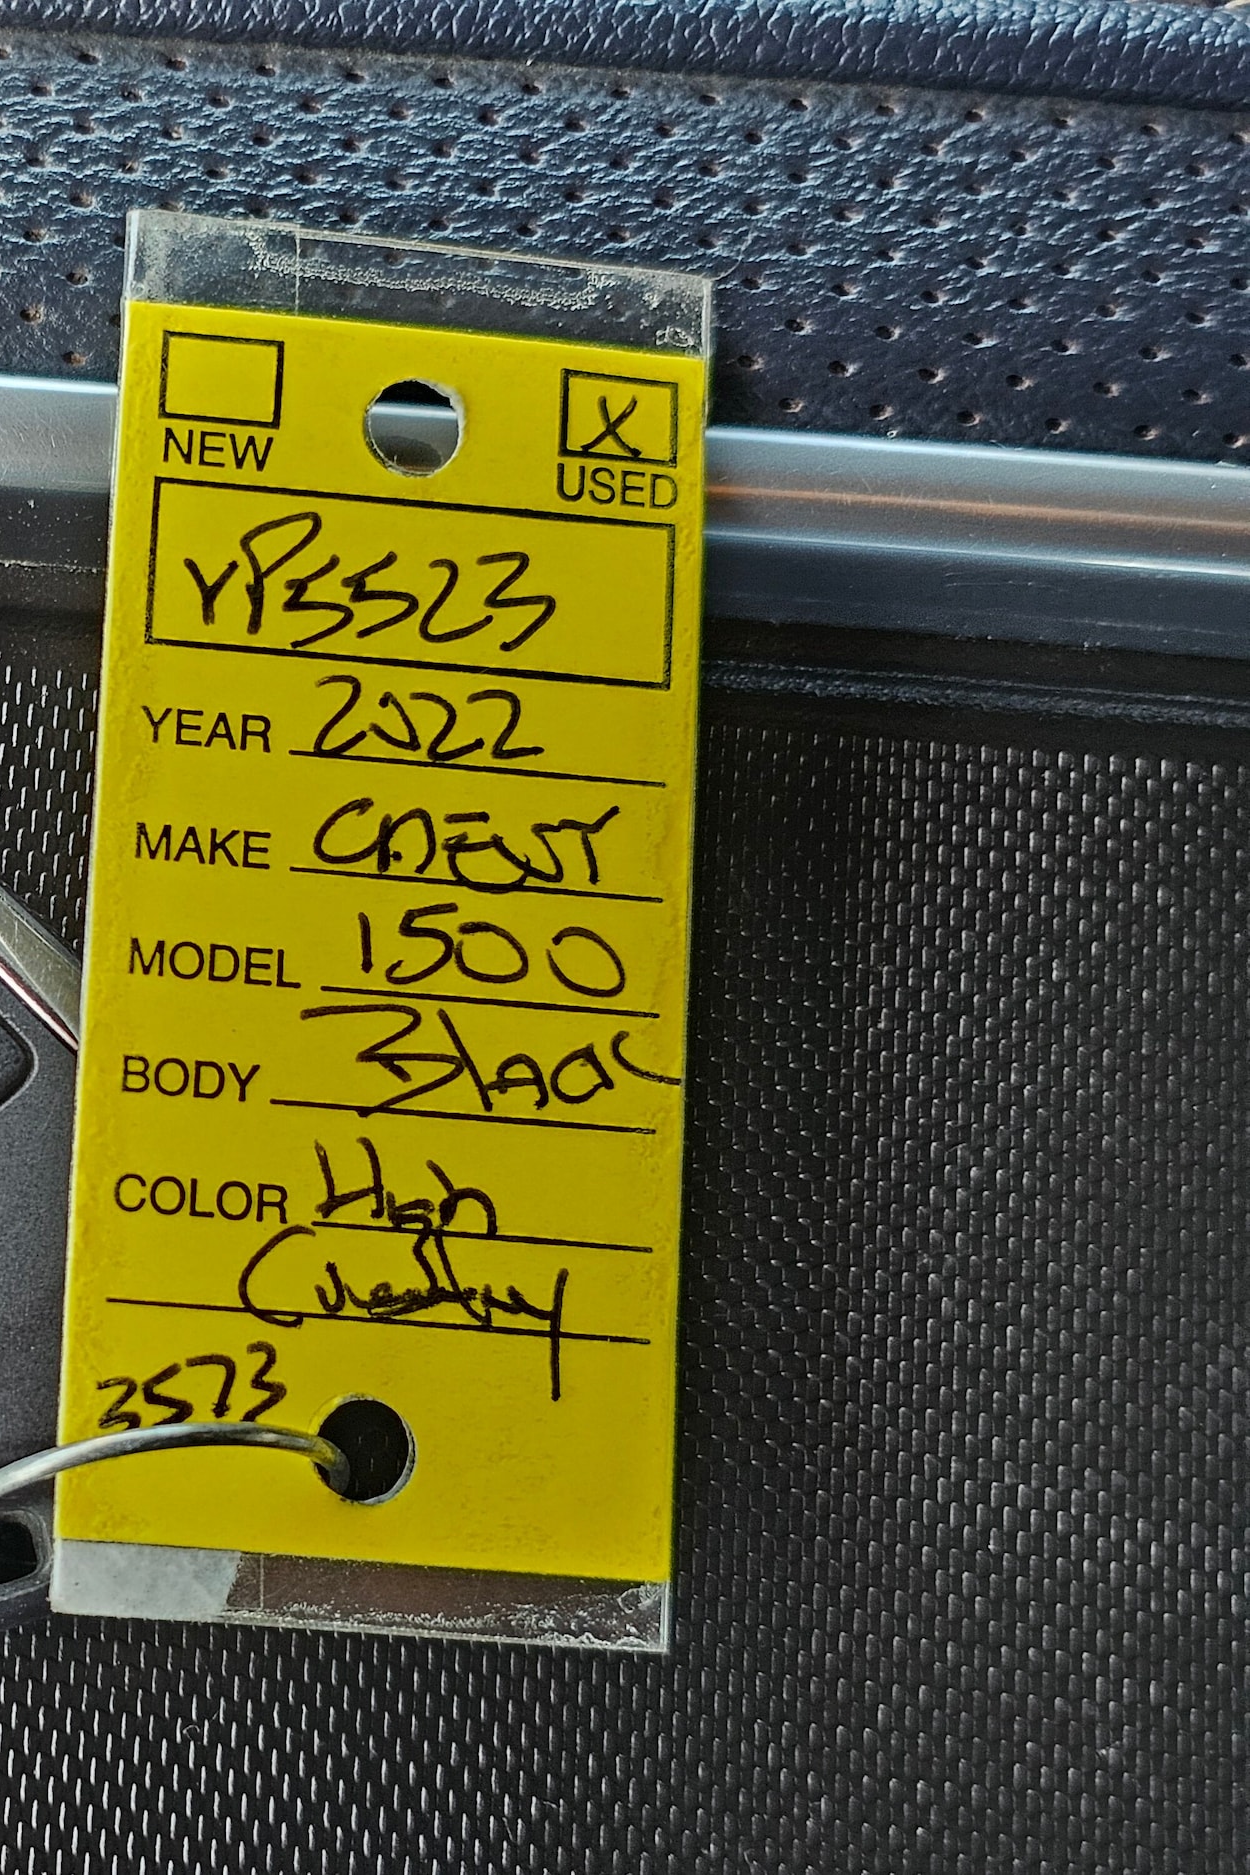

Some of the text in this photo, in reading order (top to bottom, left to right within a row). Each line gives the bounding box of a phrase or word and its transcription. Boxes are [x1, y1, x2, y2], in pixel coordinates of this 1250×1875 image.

[161, 427, 275, 472] NEW
[556, 462, 678, 509] USED
[142, 705, 271, 755] YEAR
[316, 675, 545, 763] 2022
[135, 821, 271, 869] MAKE
[128, 936, 301, 989] MODEL
[357, 902, 628, 999] 1500
[122, 1055, 261, 1102] BODY
[114, 1172, 289, 1224] COLOR
[96, 1340, 287, 1430] 3573
